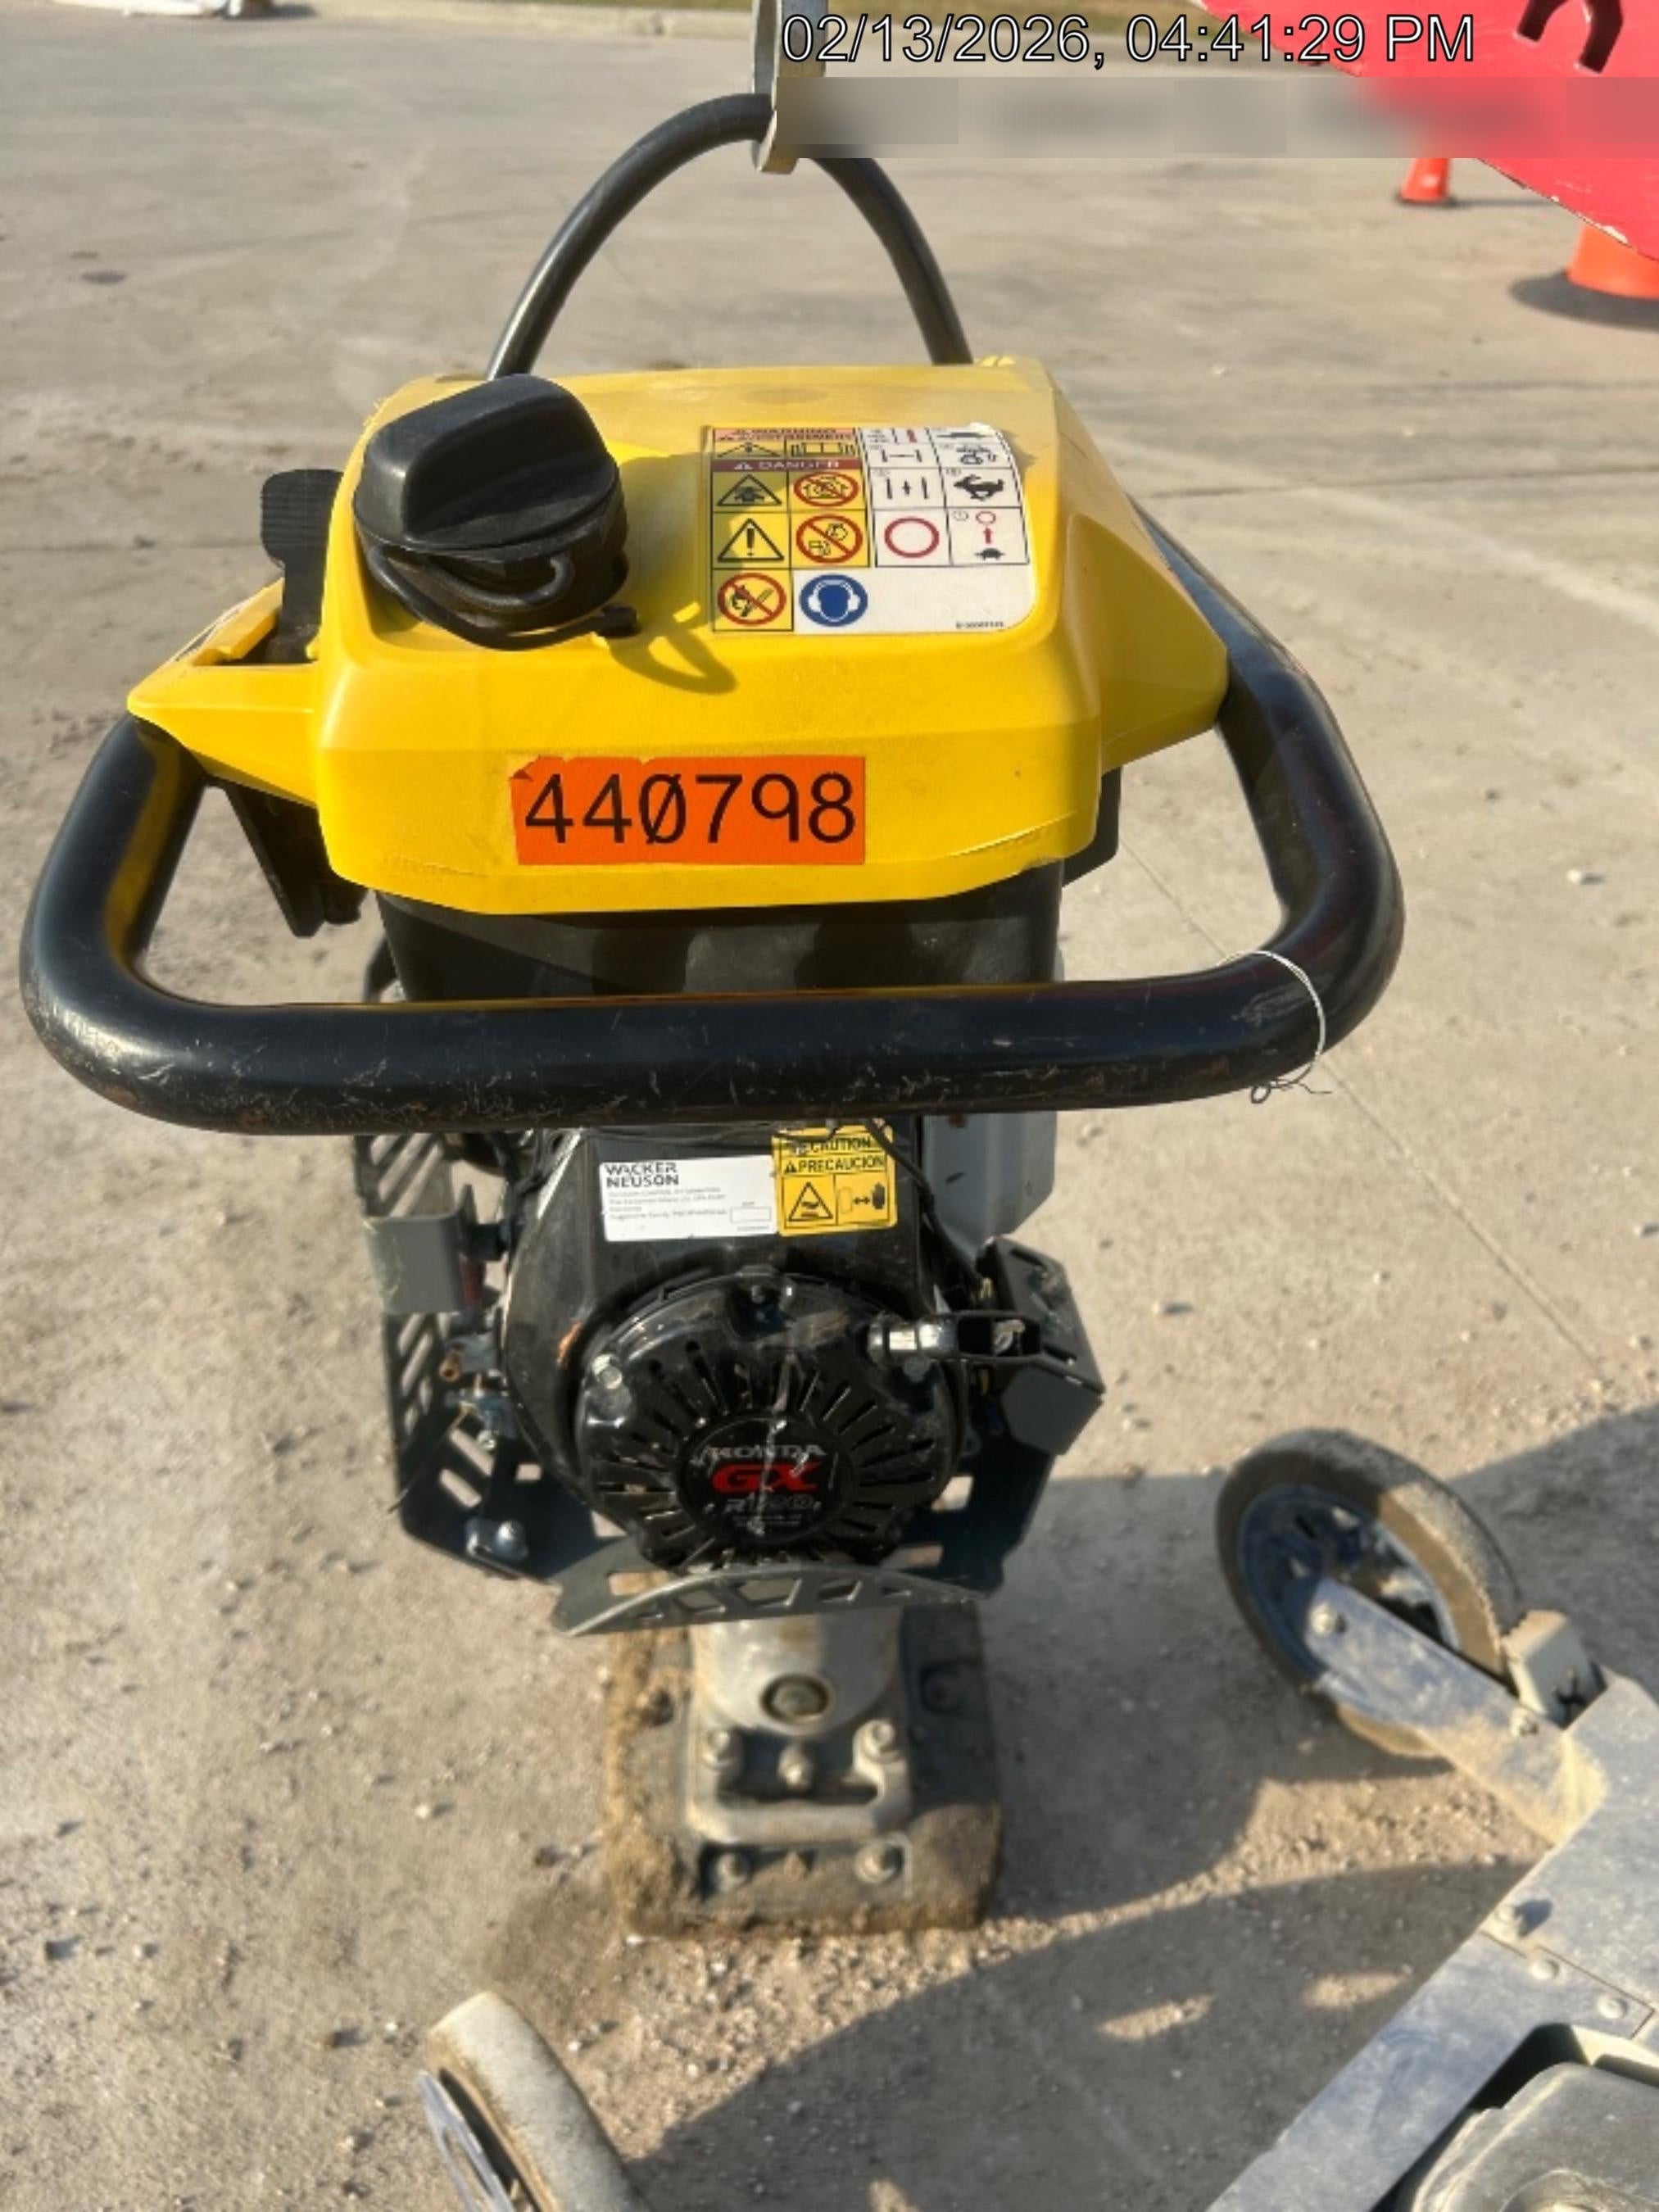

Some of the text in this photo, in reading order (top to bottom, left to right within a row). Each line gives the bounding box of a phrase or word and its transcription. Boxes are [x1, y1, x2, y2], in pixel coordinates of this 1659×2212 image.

[759, 460, 840, 469] DANGER
[525, 772, 856, 845] 440798
[605, 1162, 678, 1176] WACKER
[605, 1174, 679, 1188] NEUSON
[707, 1444, 827, 1458] HONDA
[712, 1461, 824, 1494] GX
